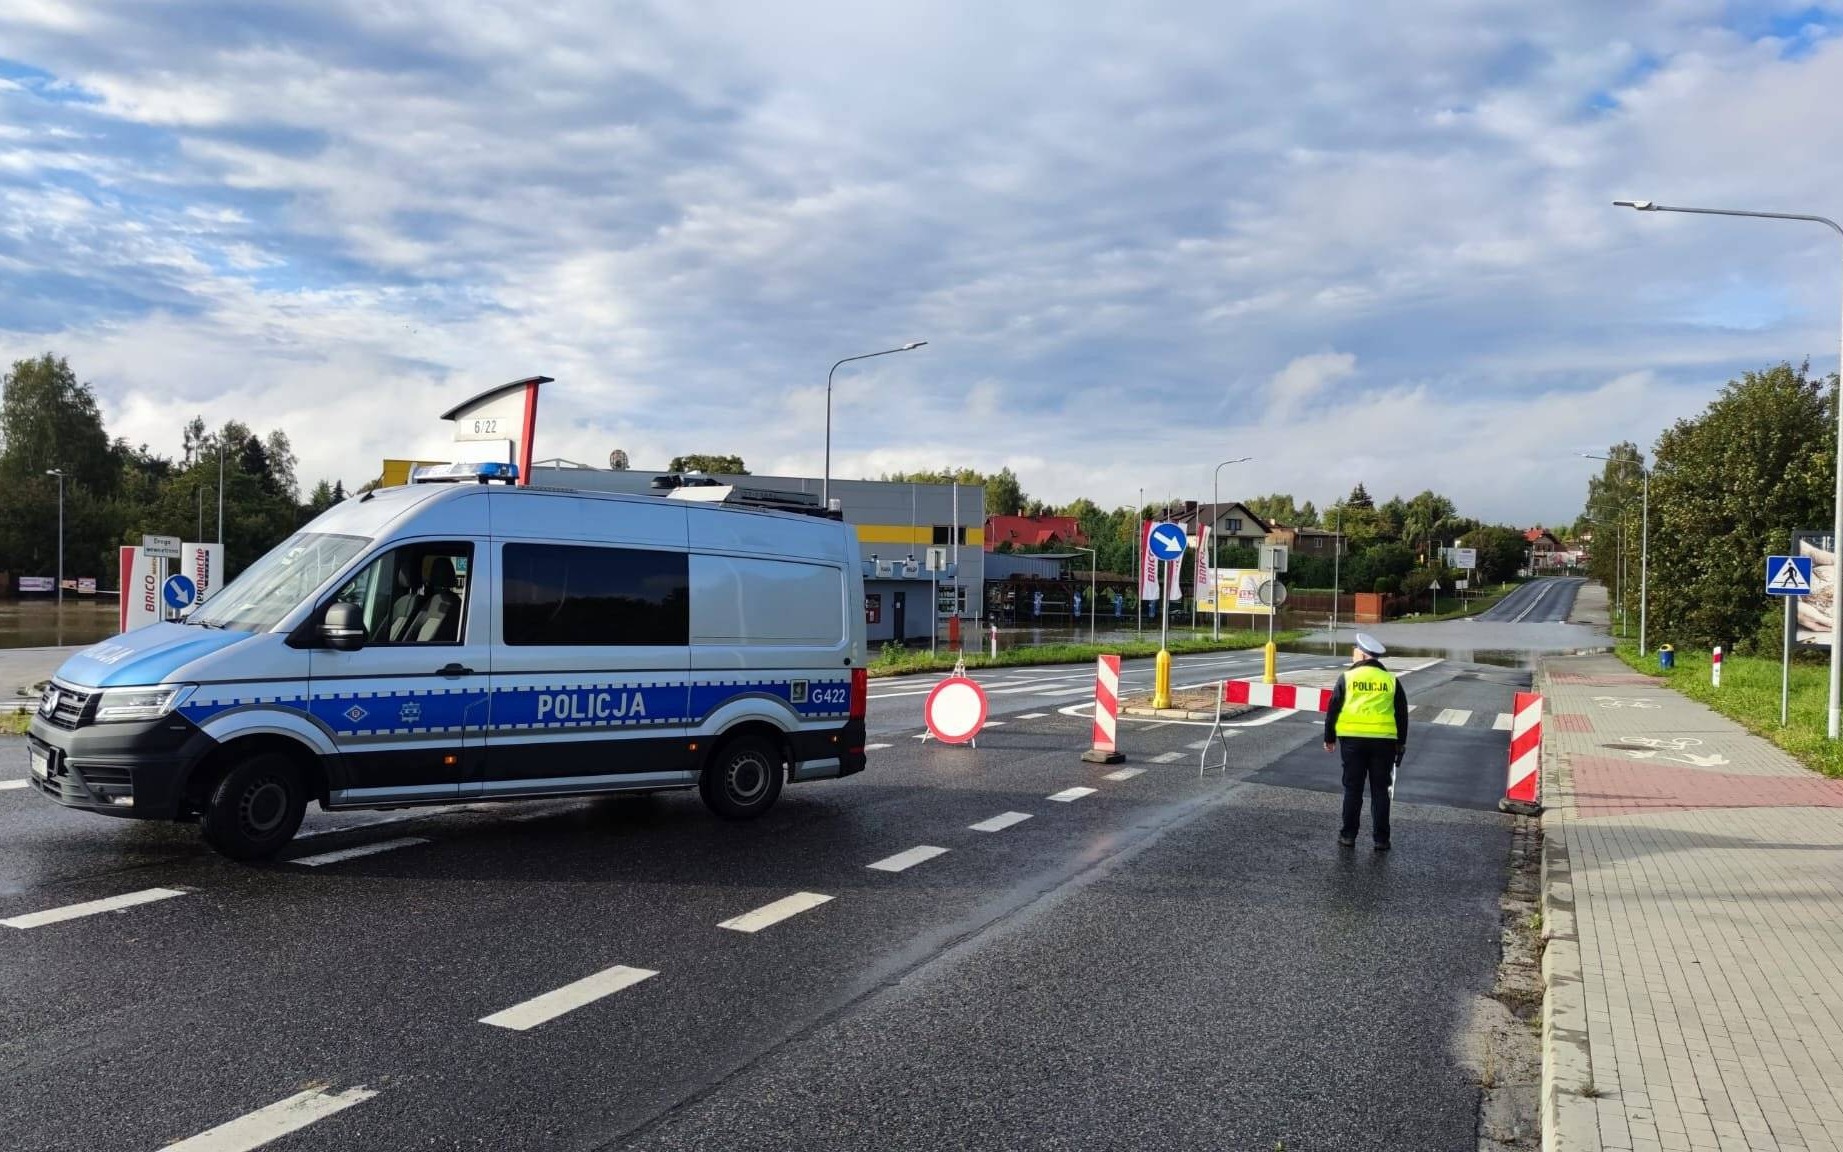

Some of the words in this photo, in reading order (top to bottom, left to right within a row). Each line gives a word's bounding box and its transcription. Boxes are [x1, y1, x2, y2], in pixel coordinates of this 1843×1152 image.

[145, 575, 155, 613] BRICO
[812, 688, 846, 704] G422
[1352, 681, 1388, 692] POLICJA
[537, 692, 646, 720] POLICJA
